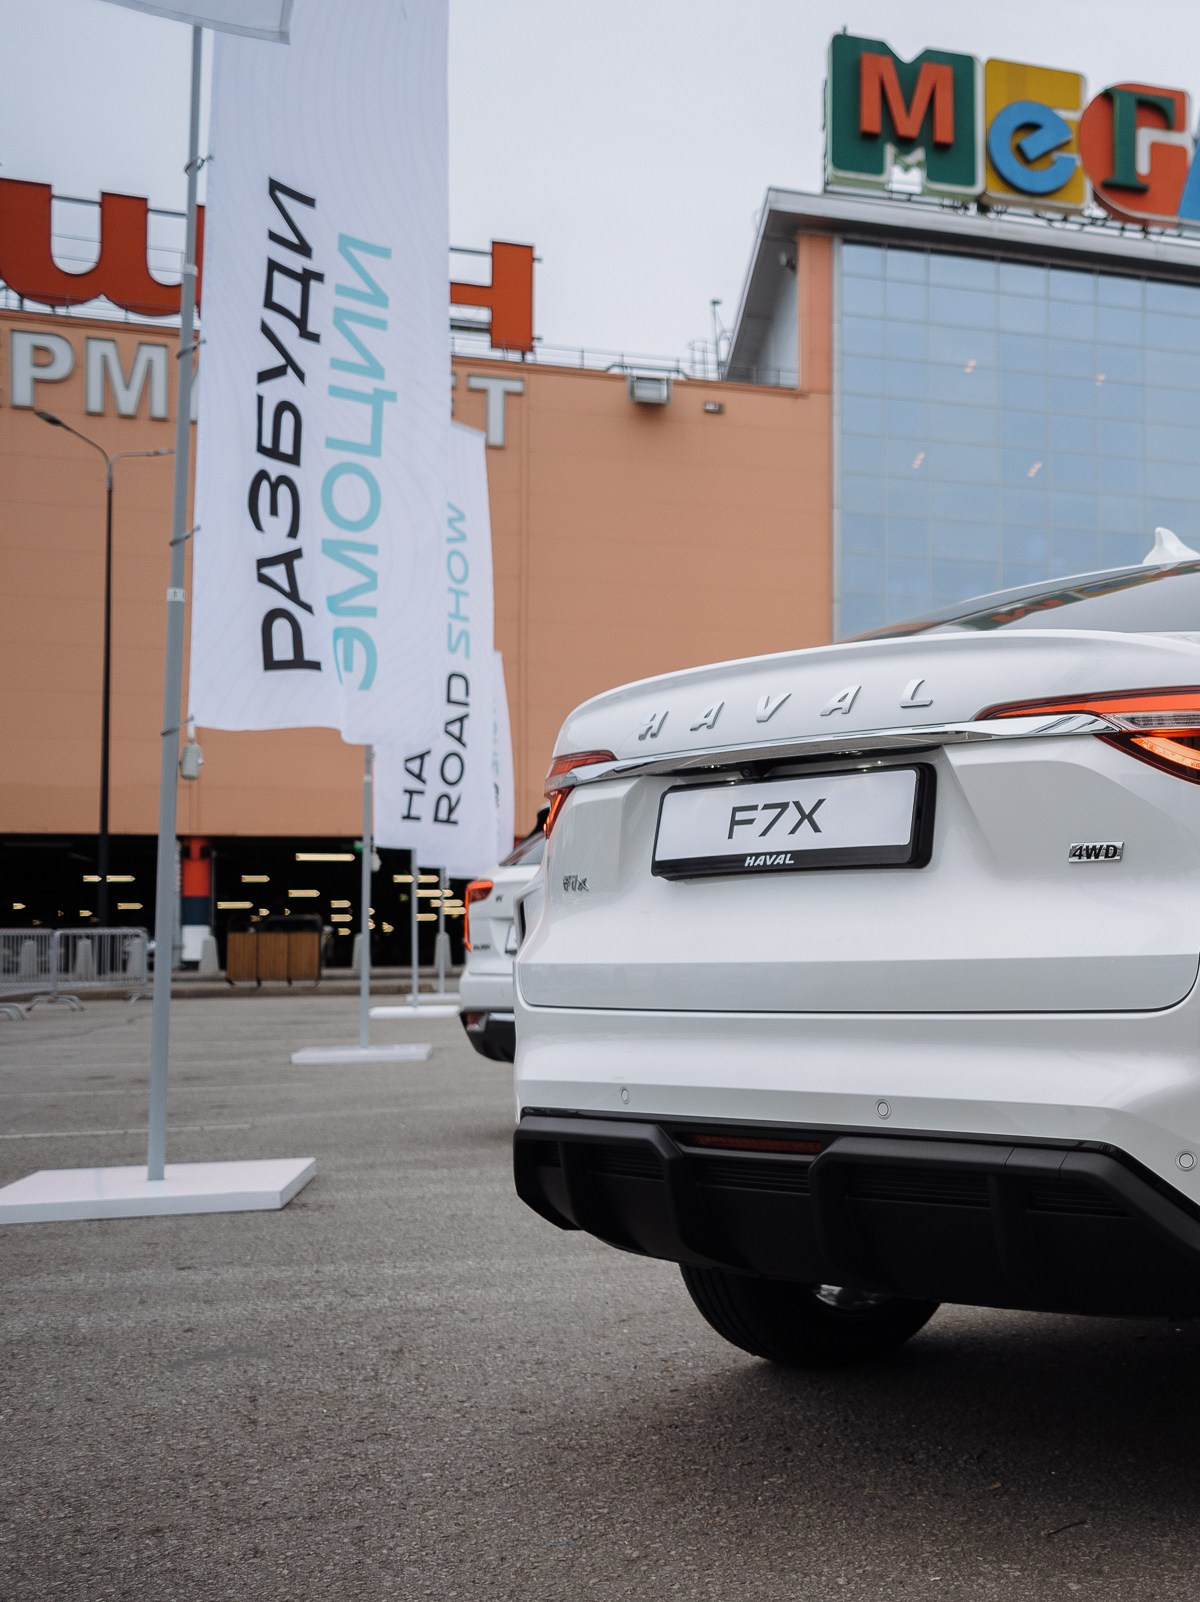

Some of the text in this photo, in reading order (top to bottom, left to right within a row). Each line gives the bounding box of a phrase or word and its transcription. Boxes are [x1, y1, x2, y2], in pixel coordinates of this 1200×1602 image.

[247, 176, 324, 672] РАЗБУДИ
[320, 232, 398, 692] ЭМОЦИИ
[433, 500, 471, 825] ROAD SHOW
[638, 679, 934, 741] HAVAL
[401, 748, 431, 822] НА
[727, 798, 827, 840] F7X
[744, 853, 795, 867] HAVAL
[1070, 843, 1120, 861] 4WD
